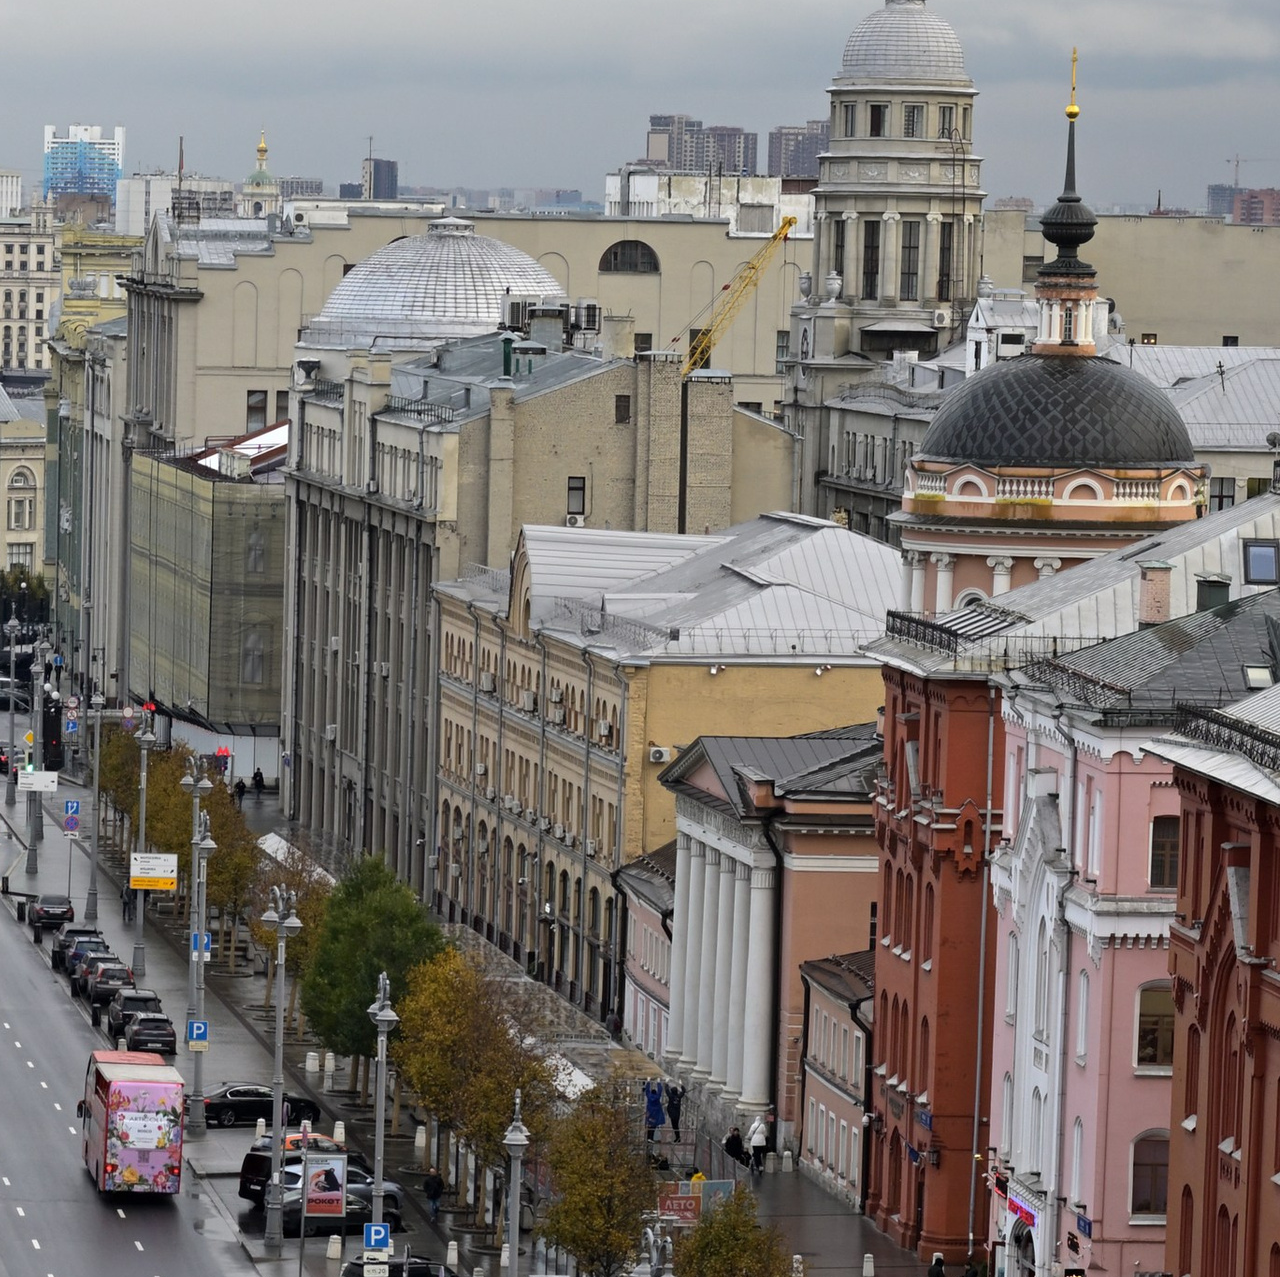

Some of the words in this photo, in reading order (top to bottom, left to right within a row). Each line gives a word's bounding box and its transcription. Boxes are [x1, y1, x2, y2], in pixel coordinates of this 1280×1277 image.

[193, 1023, 204, 1039] P
[665, 1200, 696, 1210] ЛЕТО
[371, 1226, 385, 1246] P
